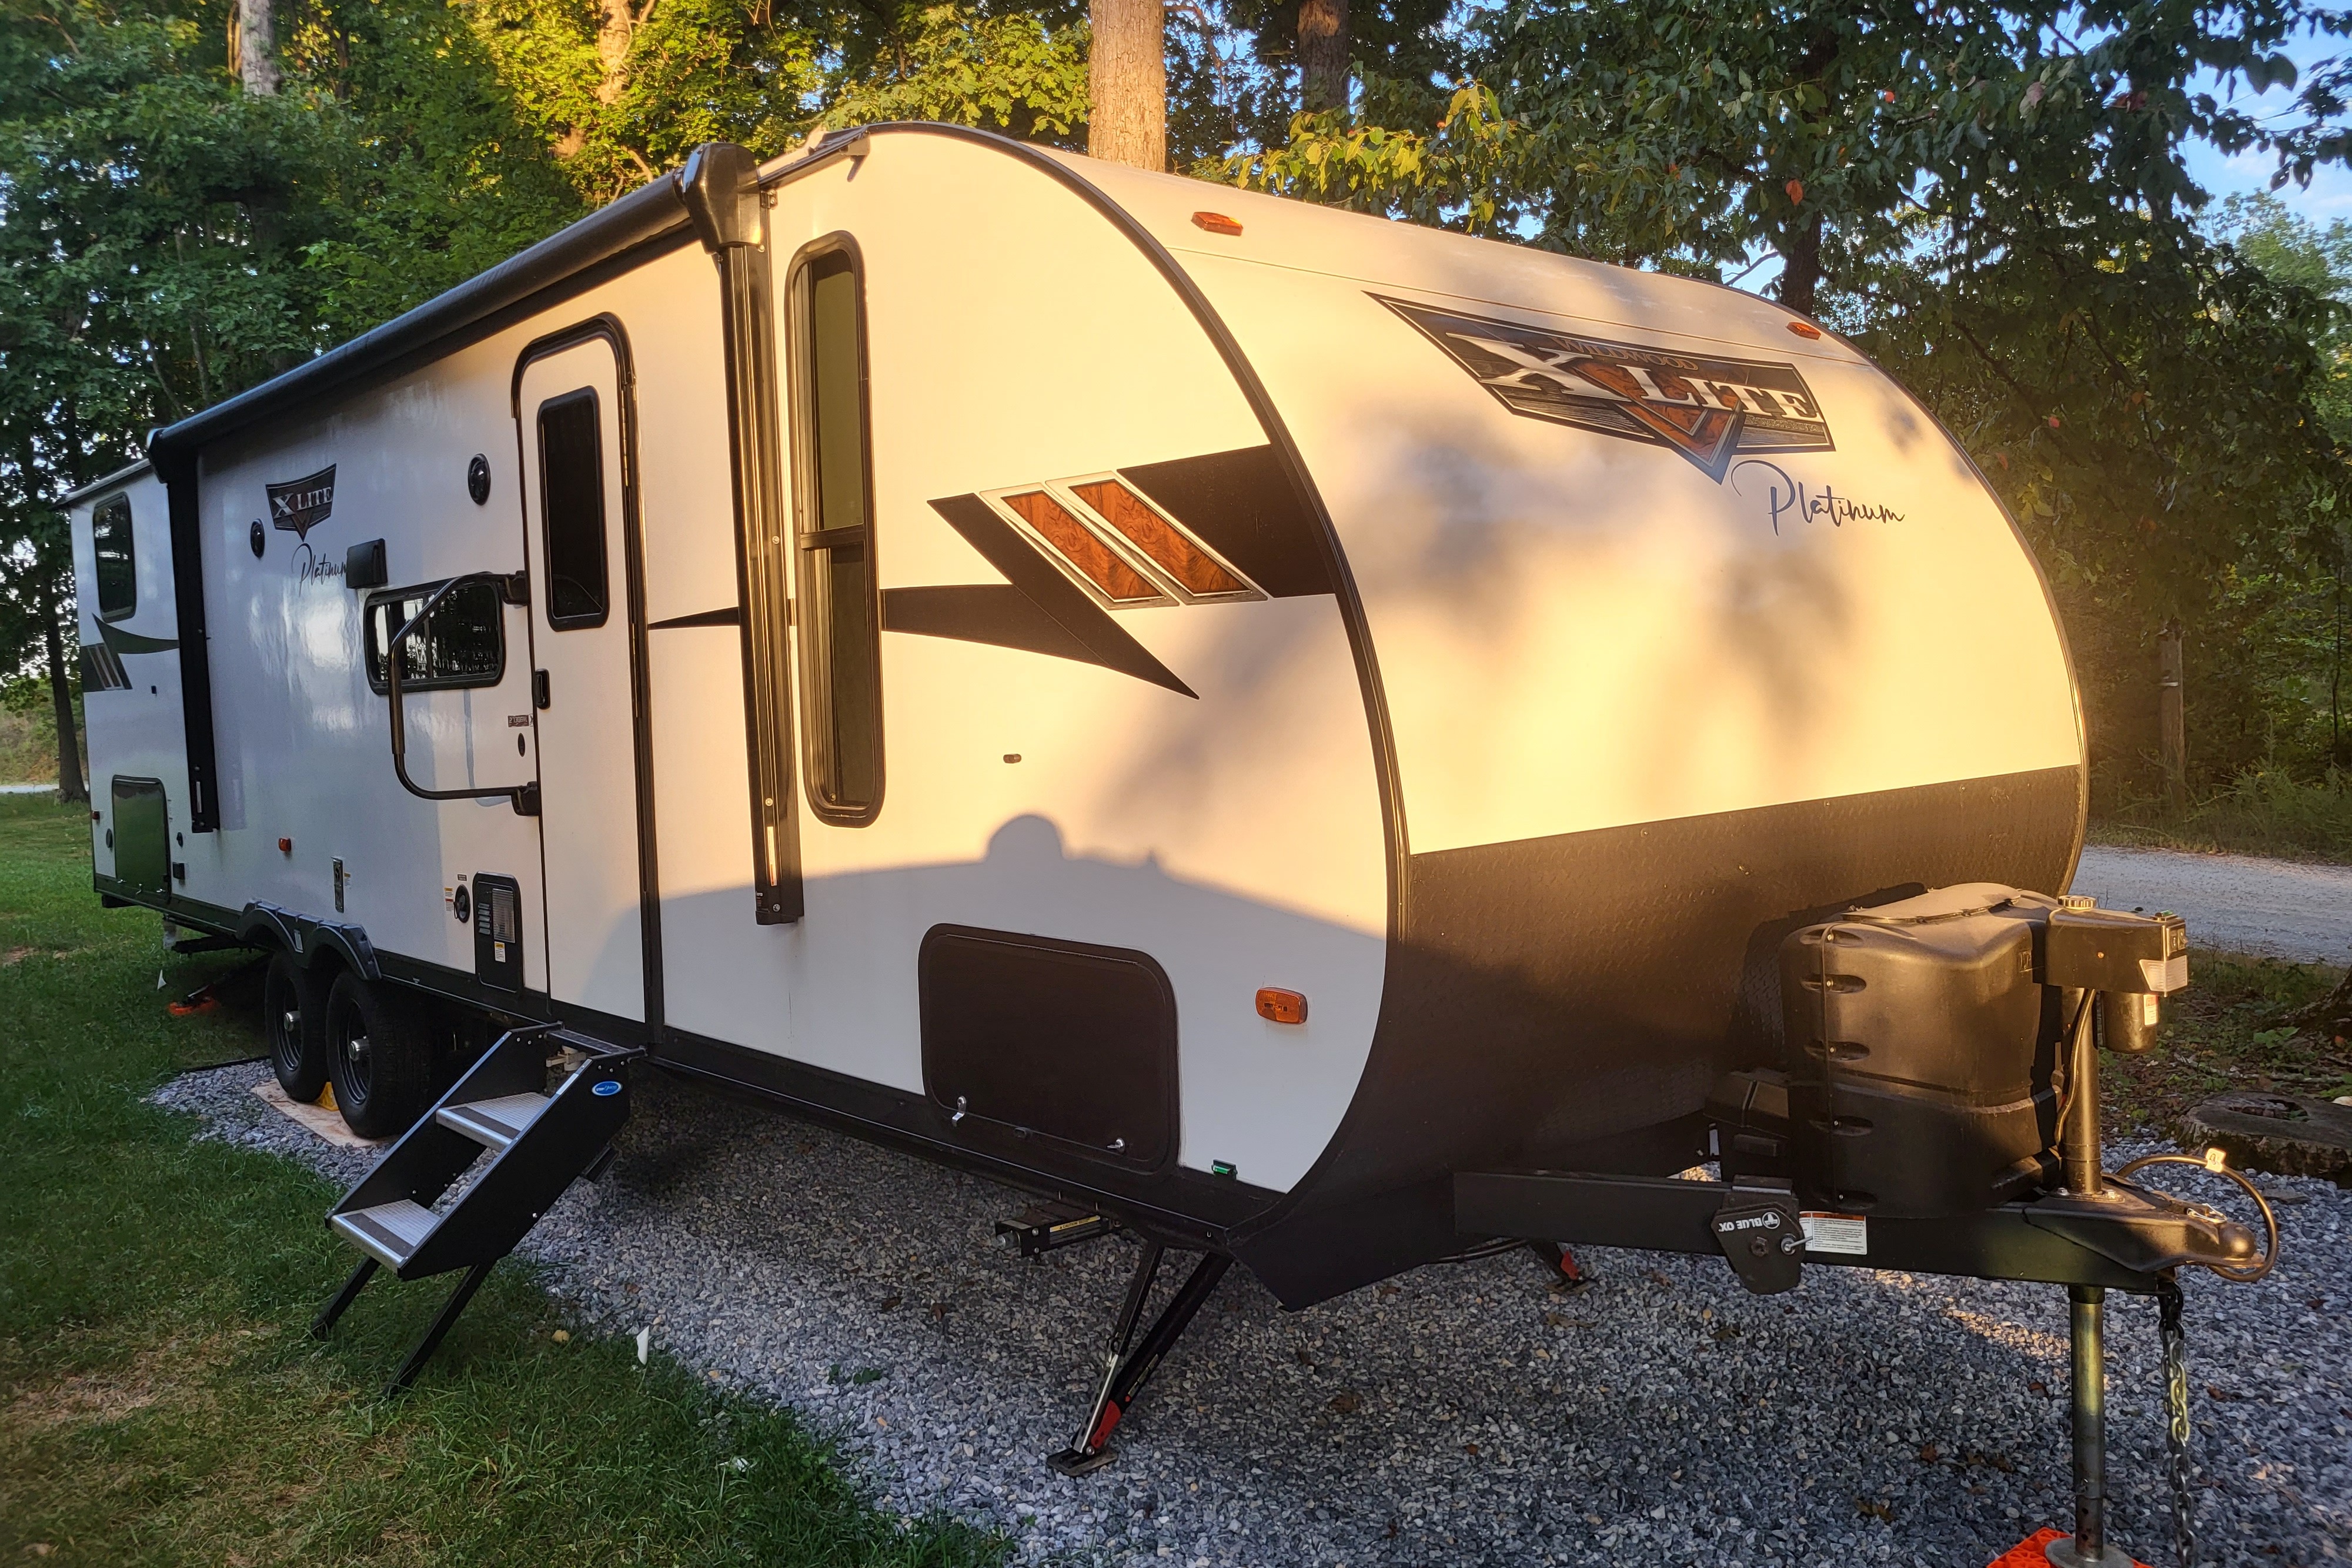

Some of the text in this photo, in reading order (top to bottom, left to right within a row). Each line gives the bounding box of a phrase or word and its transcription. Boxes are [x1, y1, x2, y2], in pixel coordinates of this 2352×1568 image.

[1548, 336, 1698, 370] WILDWOOD
[1616, 364, 1825, 423] LITE
[272, 486, 333, 519] X LITE
[1730, 459, 1905, 536] Platinum
[1718, 1217, 1763, 1232] BLUE OX
